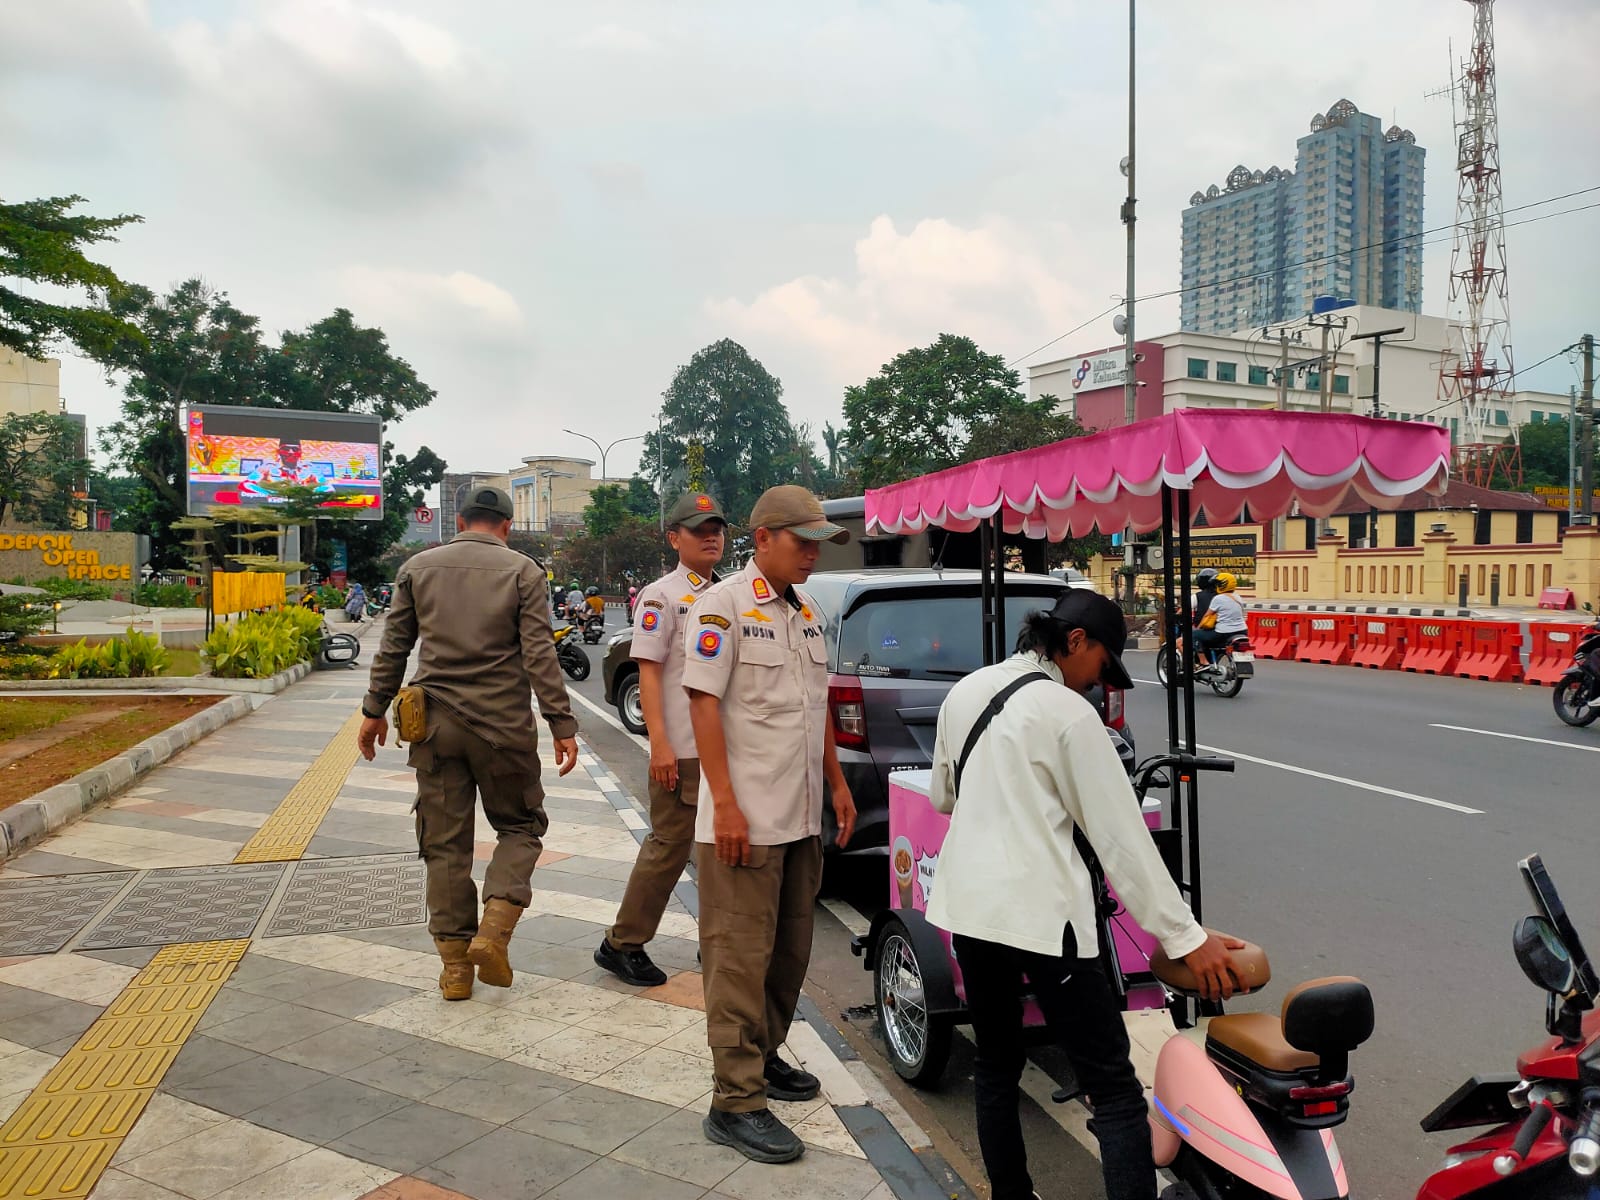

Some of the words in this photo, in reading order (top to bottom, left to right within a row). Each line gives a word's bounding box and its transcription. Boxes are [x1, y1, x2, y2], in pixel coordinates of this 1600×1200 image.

[1093, 360, 1117, 370] Mitra
[1093, 370, 1129, 383] Keluarg
[0, 534, 73, 551] DEPOK
[43, 549, 99, 566] OPEN
[67, 564, 131, 580] SPACE
[802, 627, 819, 639] POL
